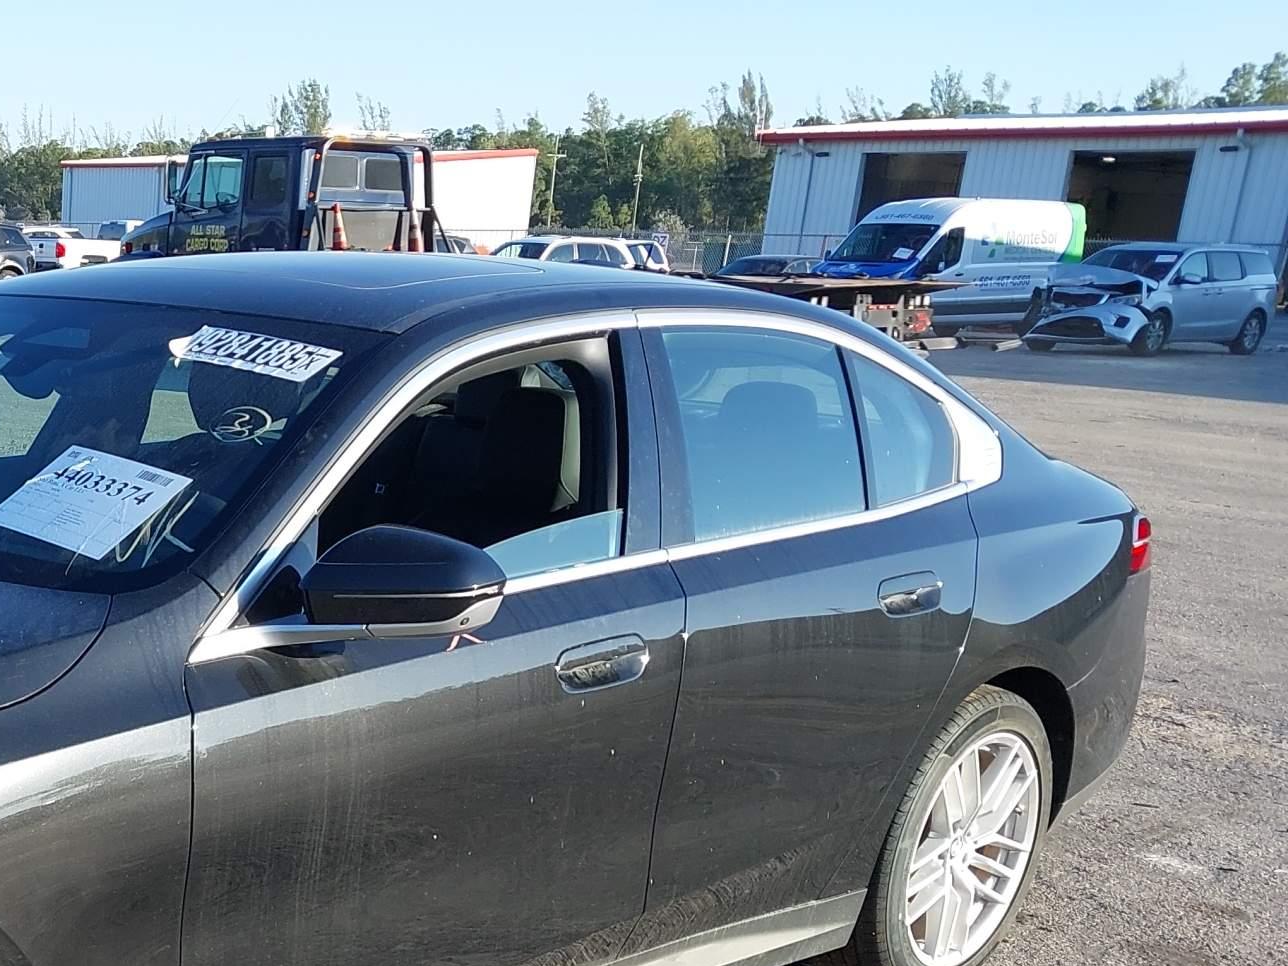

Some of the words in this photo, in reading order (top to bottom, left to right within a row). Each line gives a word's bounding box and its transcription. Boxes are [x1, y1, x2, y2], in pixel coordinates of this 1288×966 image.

[190, 225, 203, 235] ALL
[206, 224, 226, 236] STAR
[186, 238, 208, 251] CARGO
[209, 238, 229, 252] CORP
